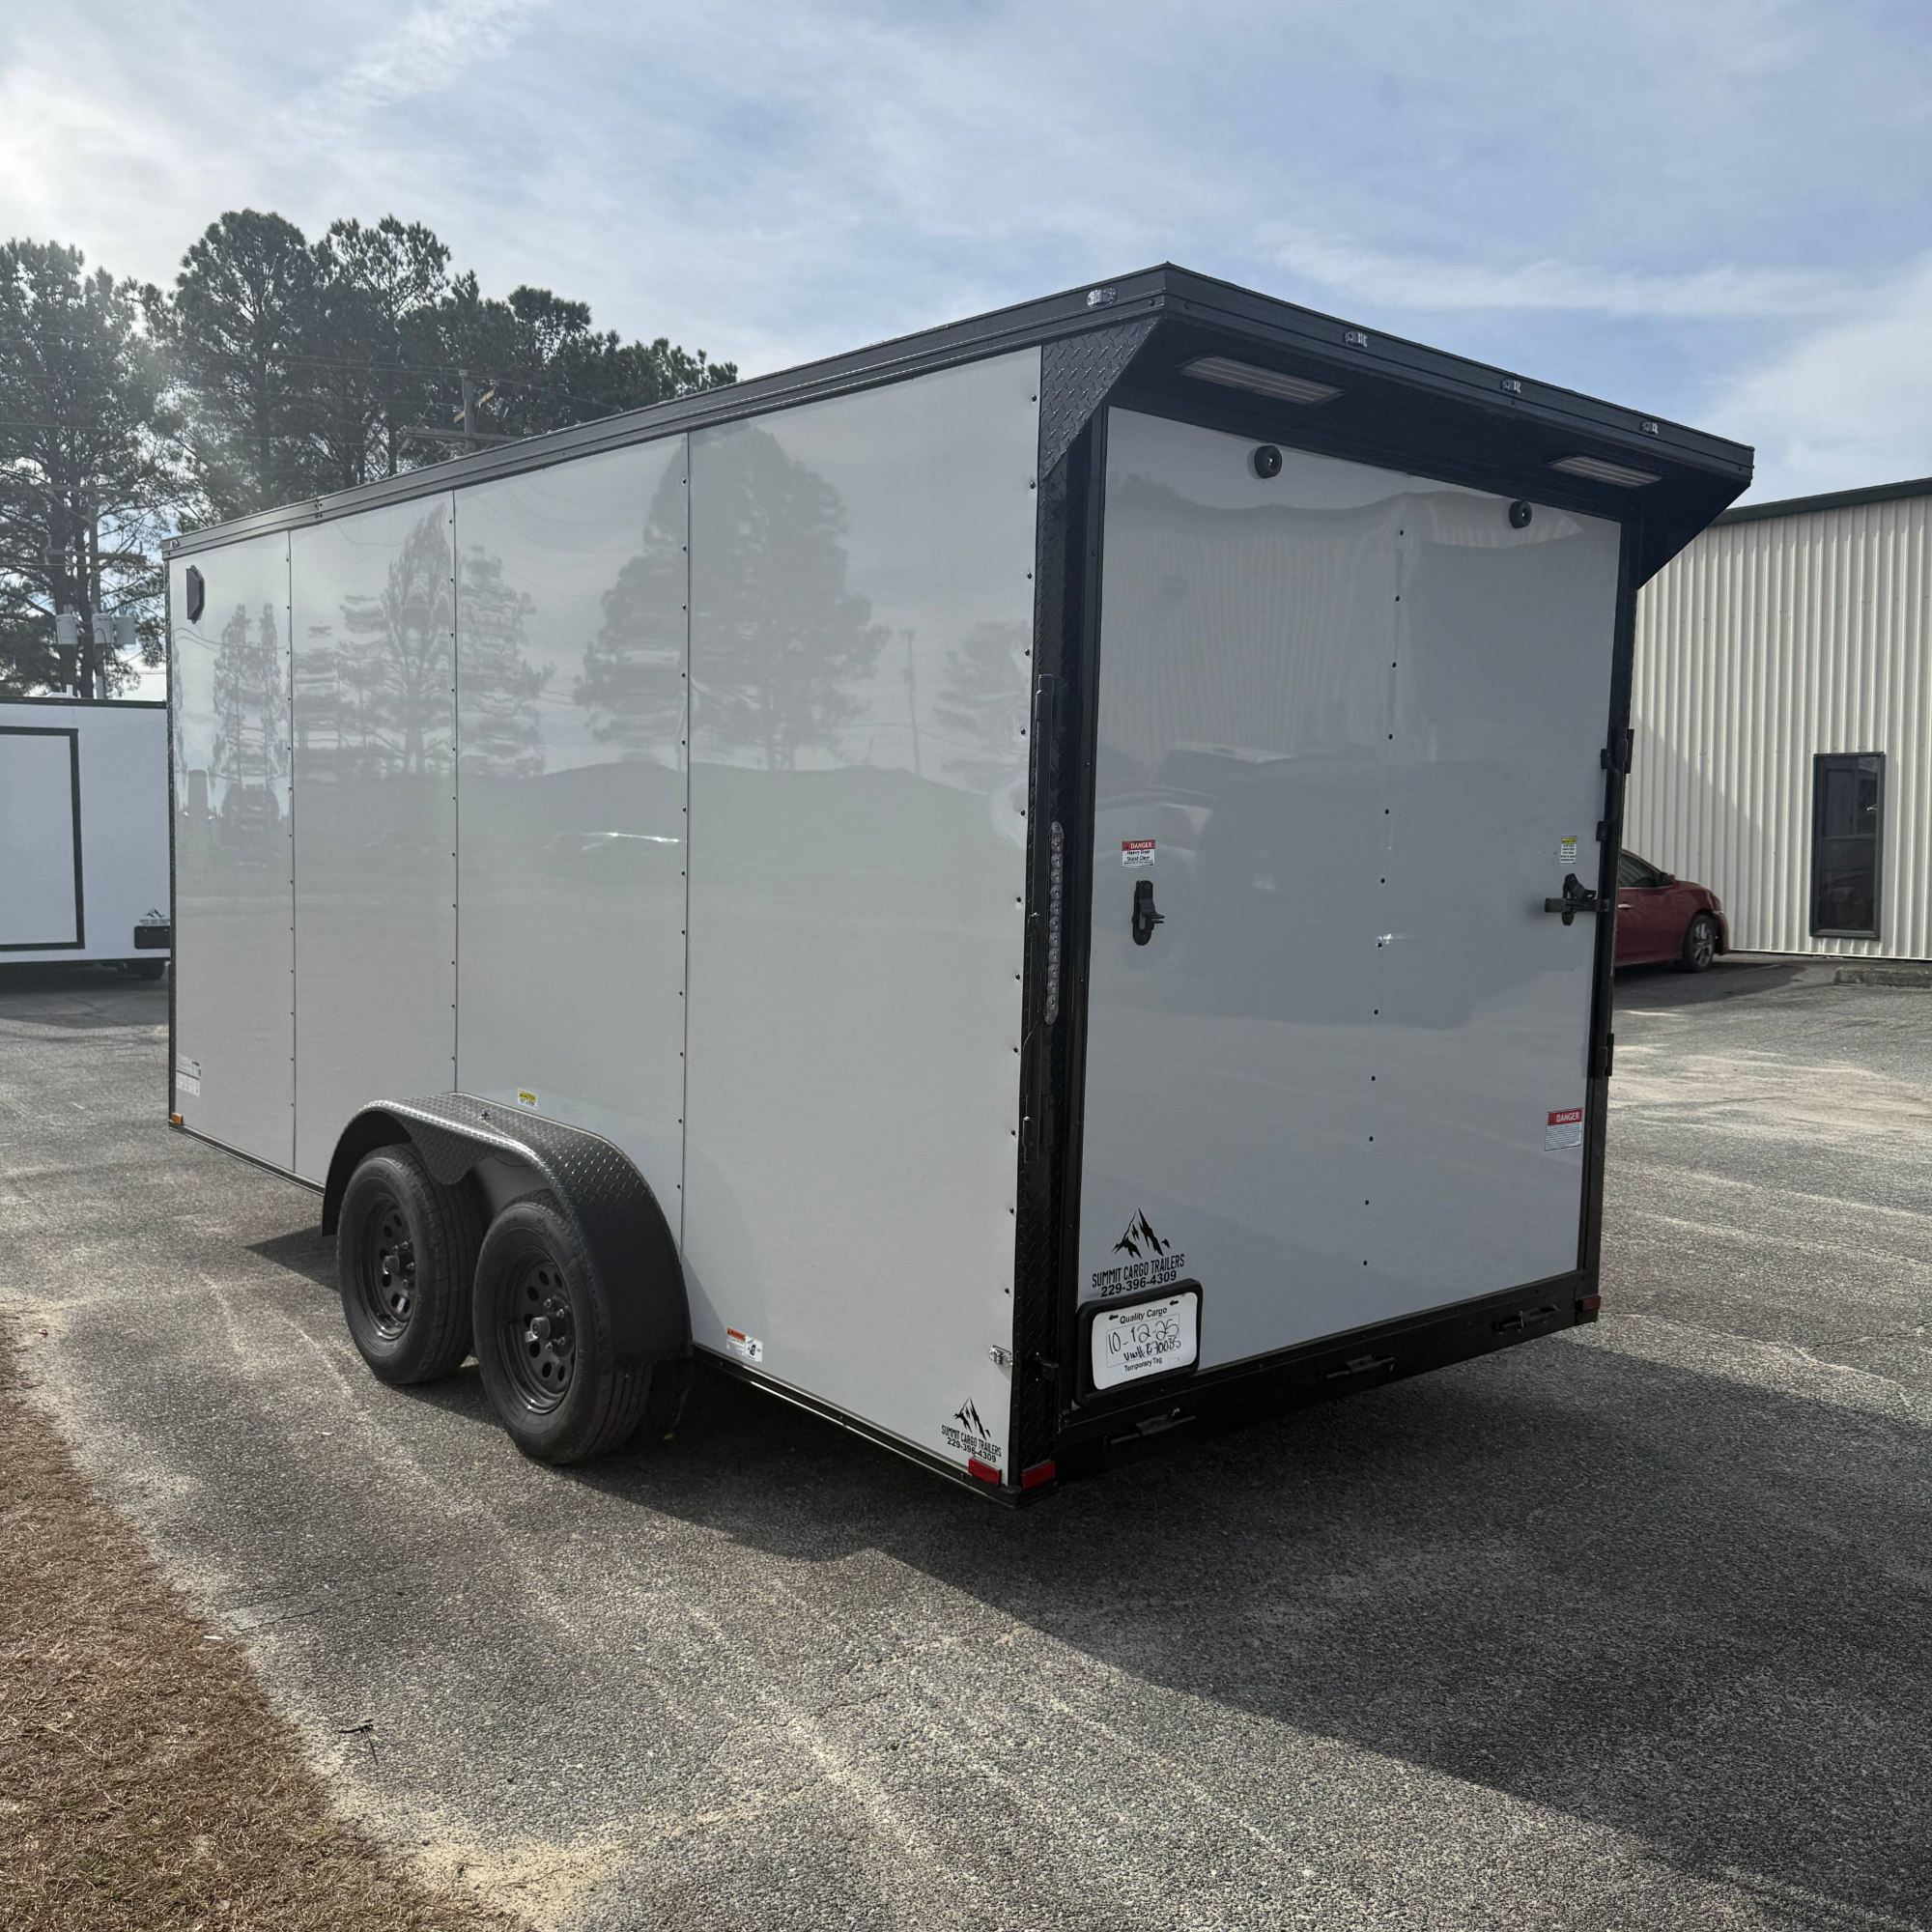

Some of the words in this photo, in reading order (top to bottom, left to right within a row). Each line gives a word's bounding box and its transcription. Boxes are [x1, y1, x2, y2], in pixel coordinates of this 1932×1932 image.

[1556, 1112, 1579, 1122] DANGER
[1092, 1267, 1122, 1288] SUMMIT
[1123, 1262, 1150, 1281] CARGO
[1151, 1253, 1185, 1273] TRAILERS
[1100, 1269, 1177, 1297] 229-396-4309
[1120, 1312, 1145, 1324] Quality
[1147, 1307, 1167, 1318] Cargo
[1123, 1358, 1152, 1373] Temporary
[942, 1425, 960, 1440] SUMMIT
[960, 1432, 978, 1447] CARGO
[978, 1438, 1002, 1457] TRAILERS
[947, 1436, 997, 1463] 229-396-4309
